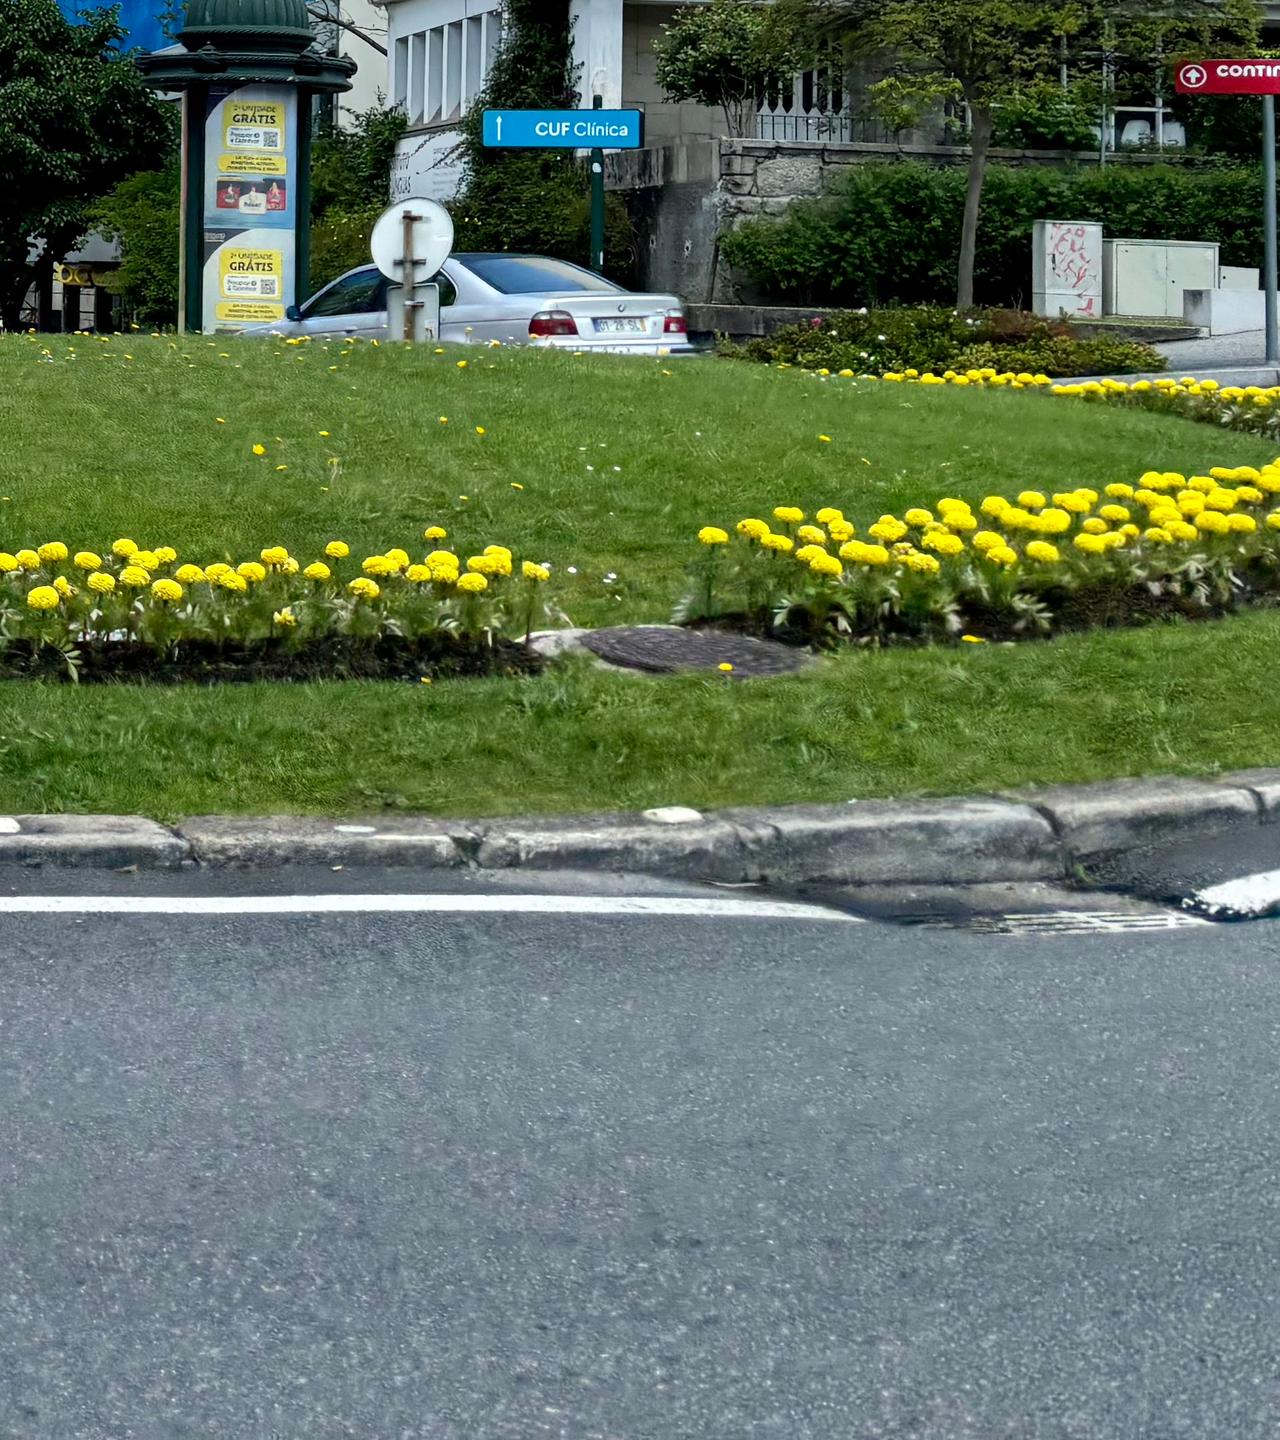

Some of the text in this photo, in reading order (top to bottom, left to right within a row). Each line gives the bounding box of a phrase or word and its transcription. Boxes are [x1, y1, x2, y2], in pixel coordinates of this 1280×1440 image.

[232, 111, 276, 124] GRÁTIS
[535, 121, 629, 137] CUF Clínica
[229, 259, 273, 272] GRÁTIS
